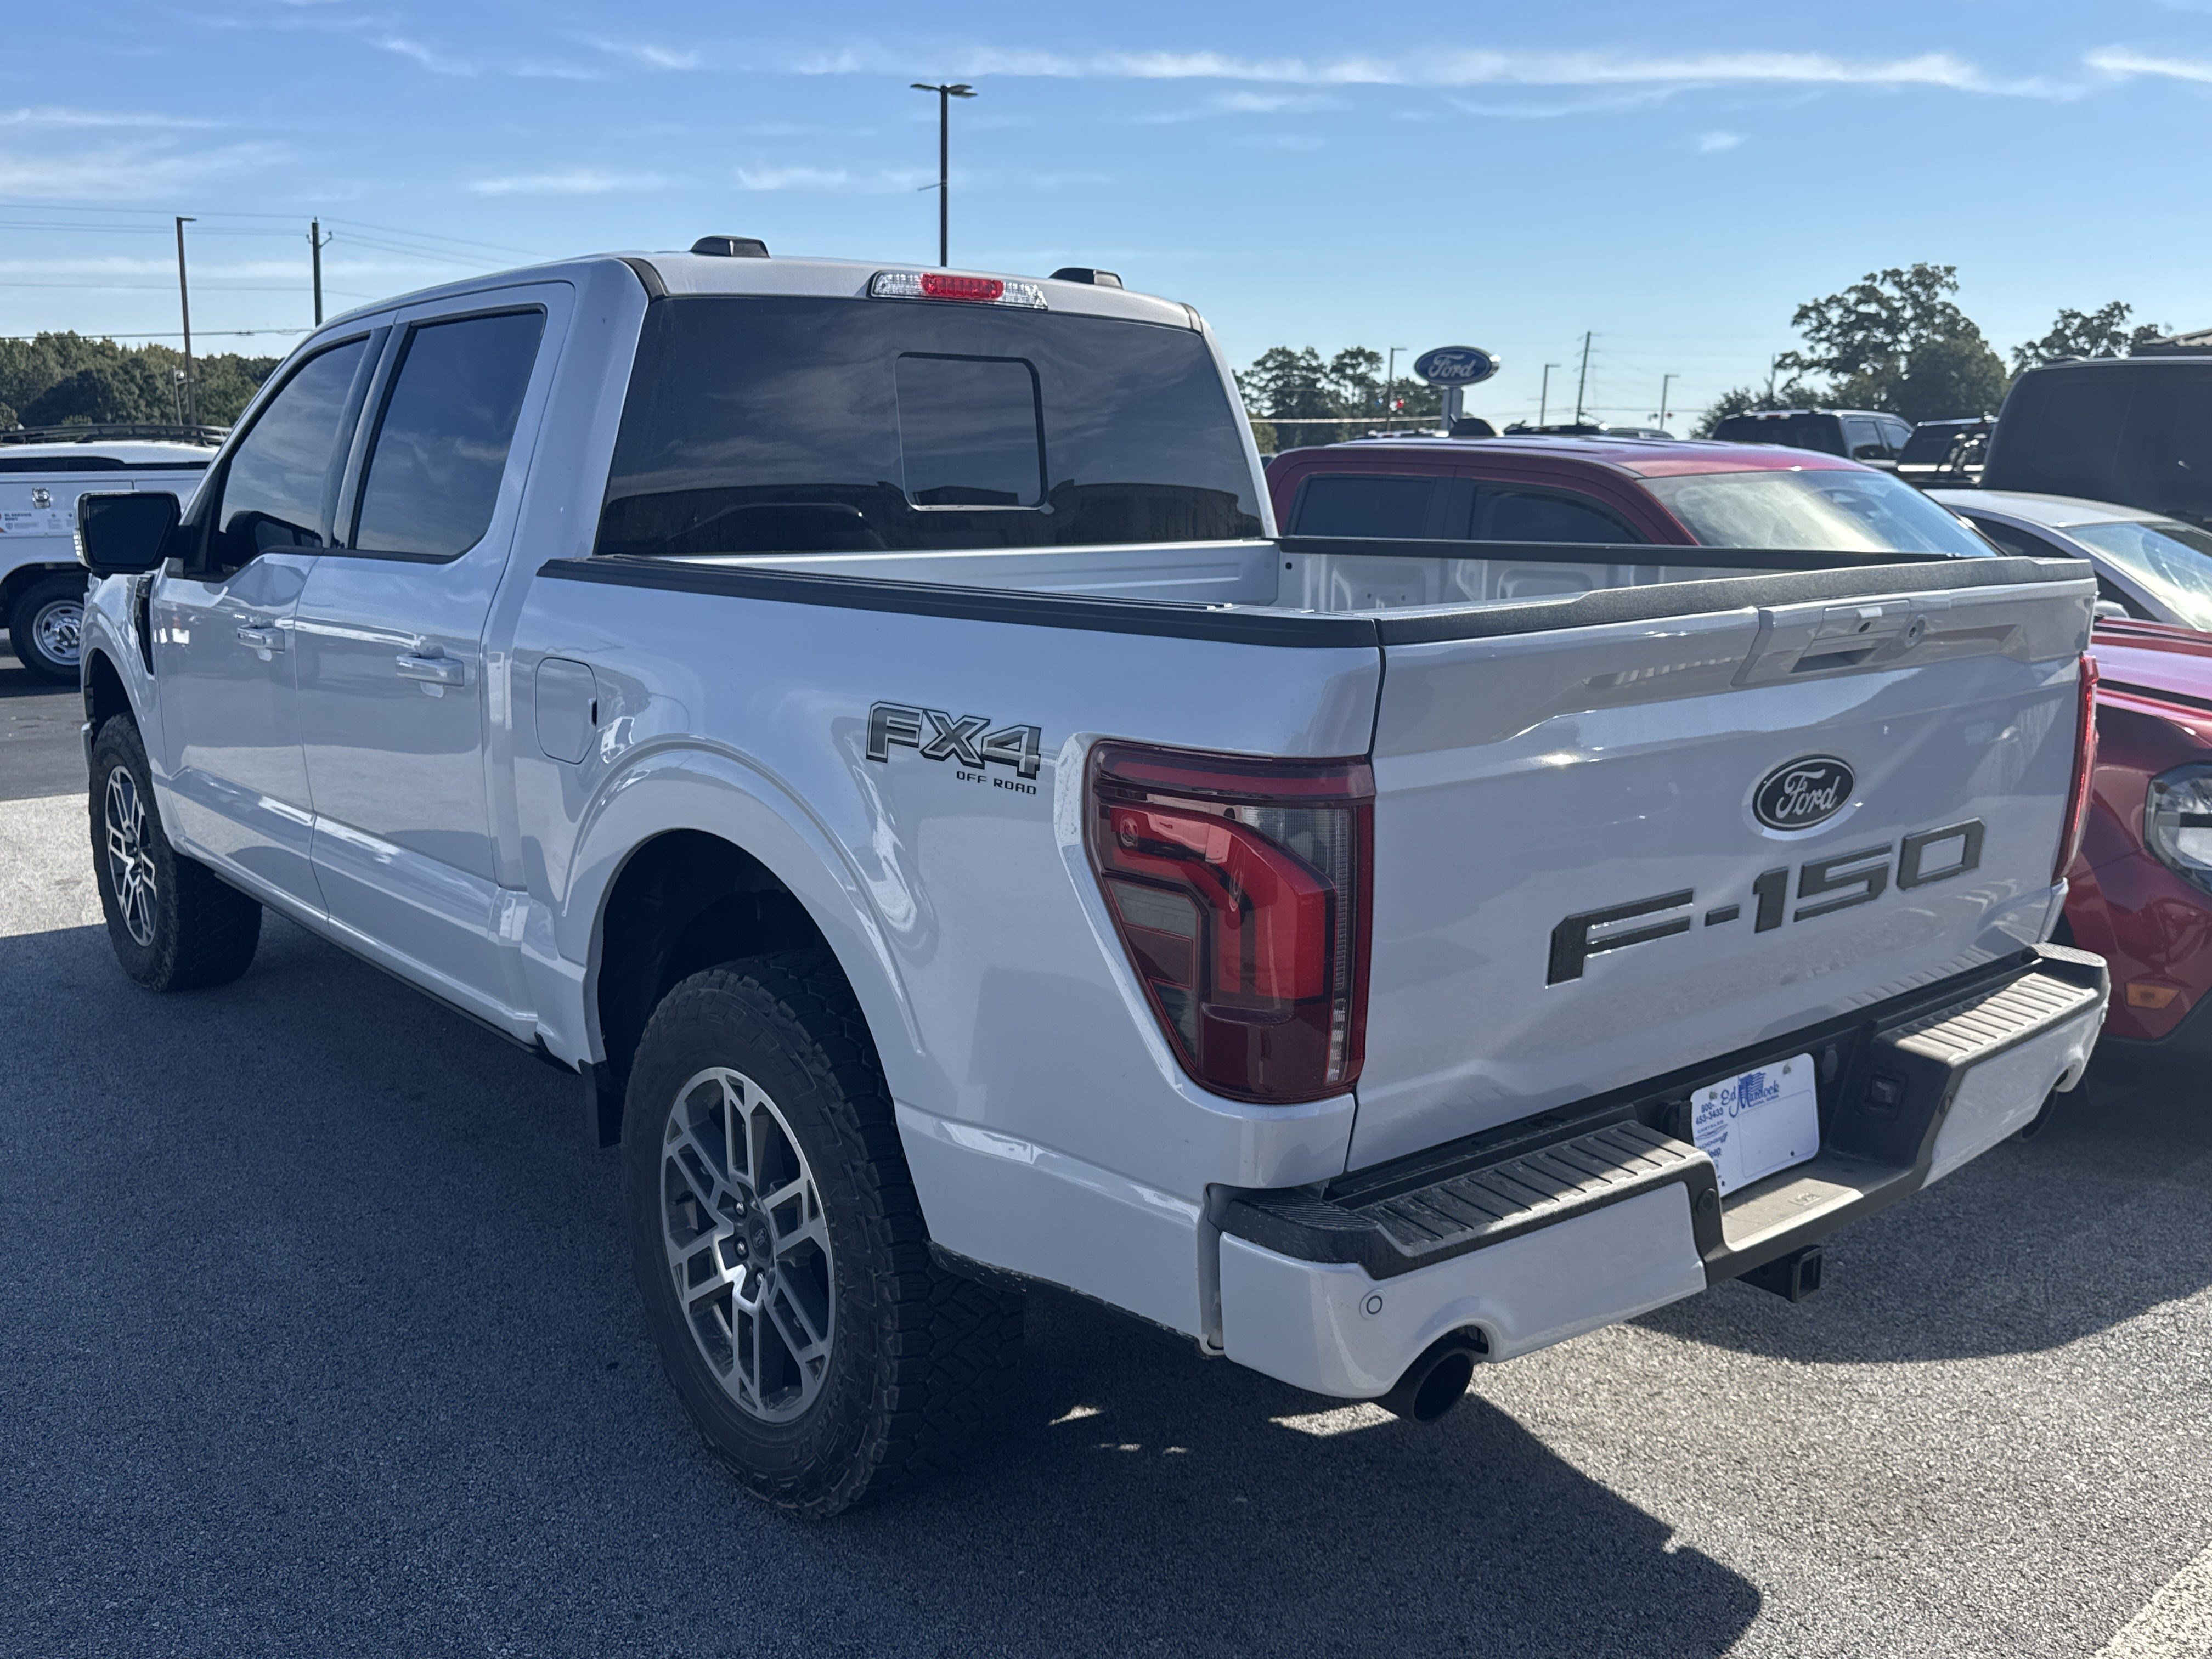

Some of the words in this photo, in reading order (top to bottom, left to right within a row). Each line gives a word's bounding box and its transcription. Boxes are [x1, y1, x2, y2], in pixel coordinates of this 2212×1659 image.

[1428, 353, 1476, 378] Ford
[866, 701, 1042, 780] FX4
[956, 771, 987, 783] OFF
[993, 778, 1036, 795] ROAD
[1774, 769, 1841, 820] Ford
[1546, 817, 1986, 988] F-150
[1720, 1085, 1736, 1106] Ed
